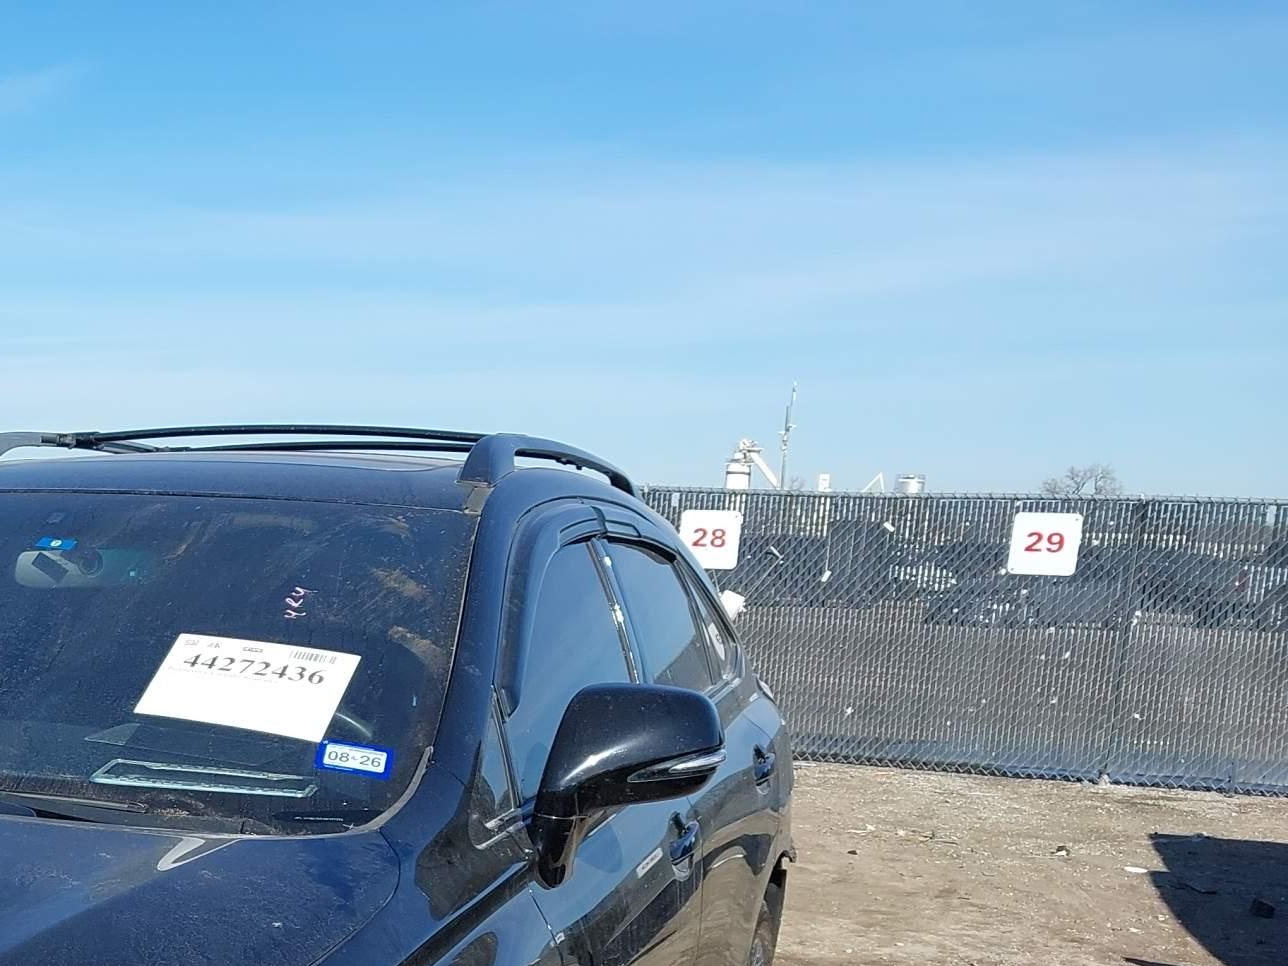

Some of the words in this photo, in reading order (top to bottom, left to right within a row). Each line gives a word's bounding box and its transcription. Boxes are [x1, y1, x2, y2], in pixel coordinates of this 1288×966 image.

[692, 528, 726, 549] 28
[1024, 532, 1065, 553] 29
[183, 653, 328, 685] 44272436
